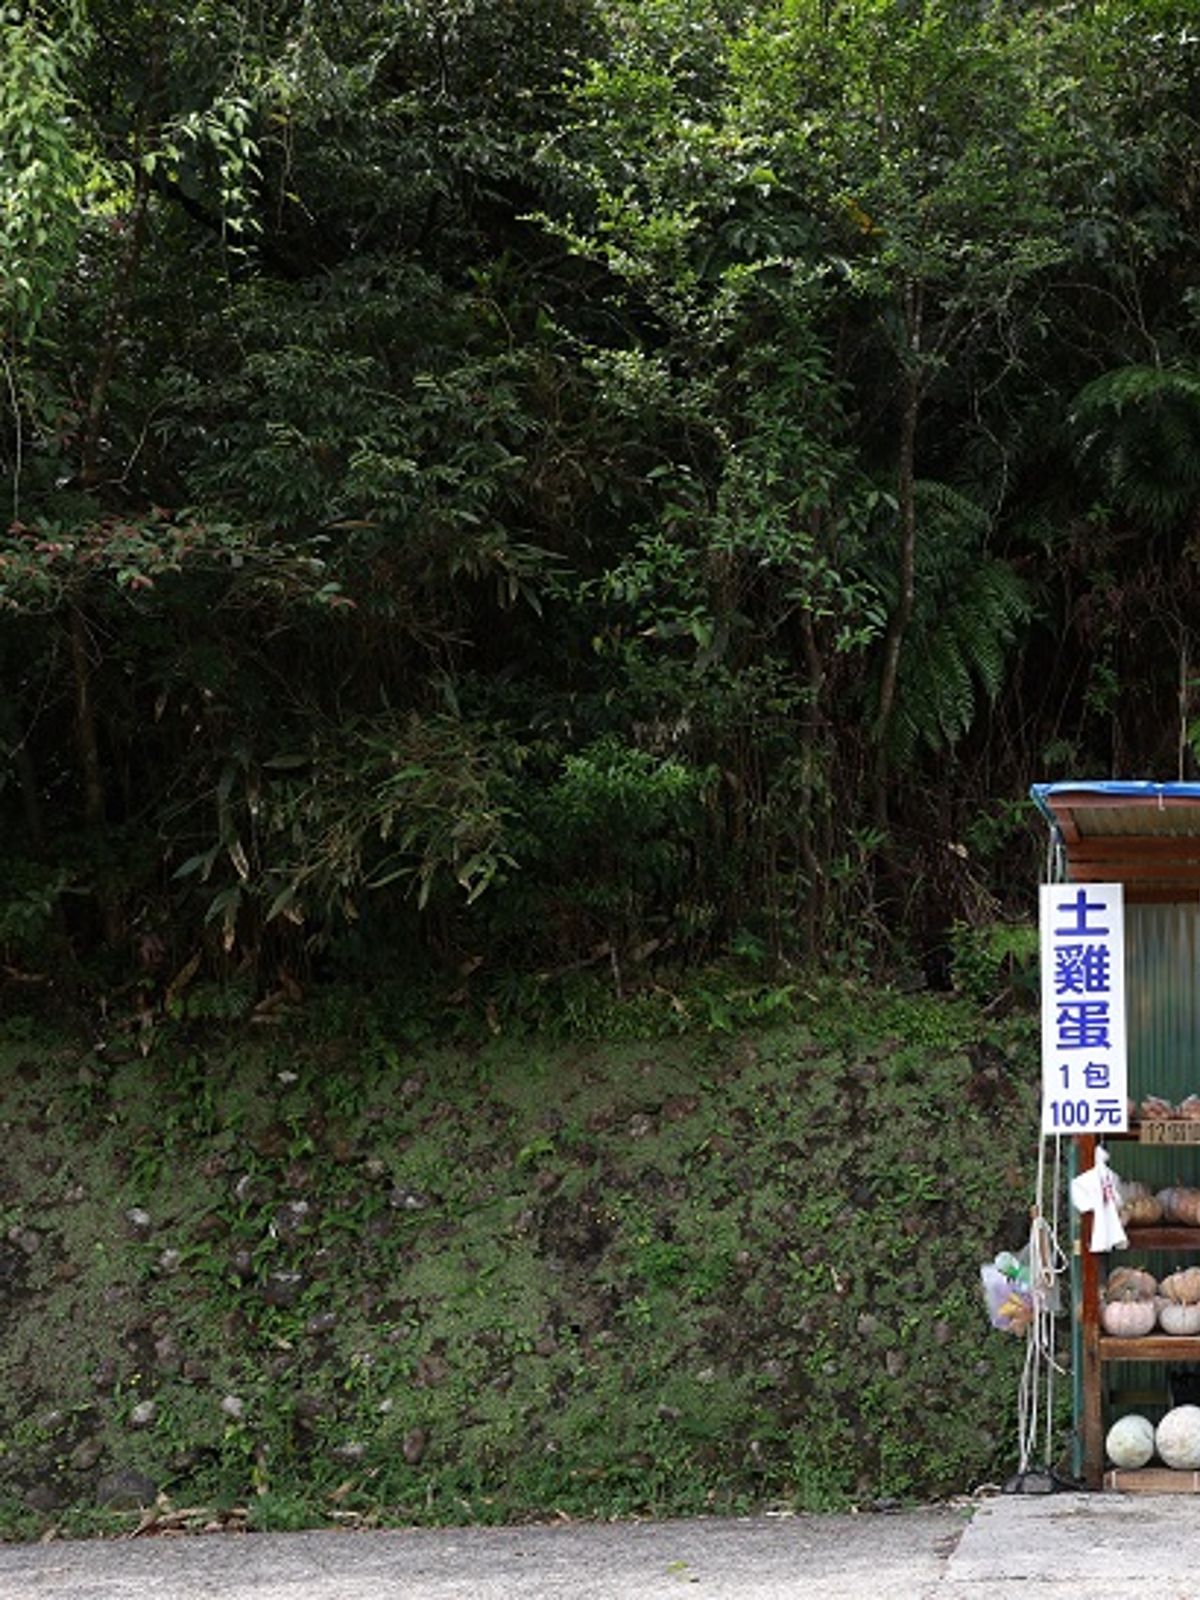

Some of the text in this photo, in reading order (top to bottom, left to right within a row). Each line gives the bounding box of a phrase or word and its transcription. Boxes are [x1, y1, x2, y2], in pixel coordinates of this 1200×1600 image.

[1054, 889, 1111, 1050] 土雞蛋
[1050, 1099, 1121, 1126] 100元
